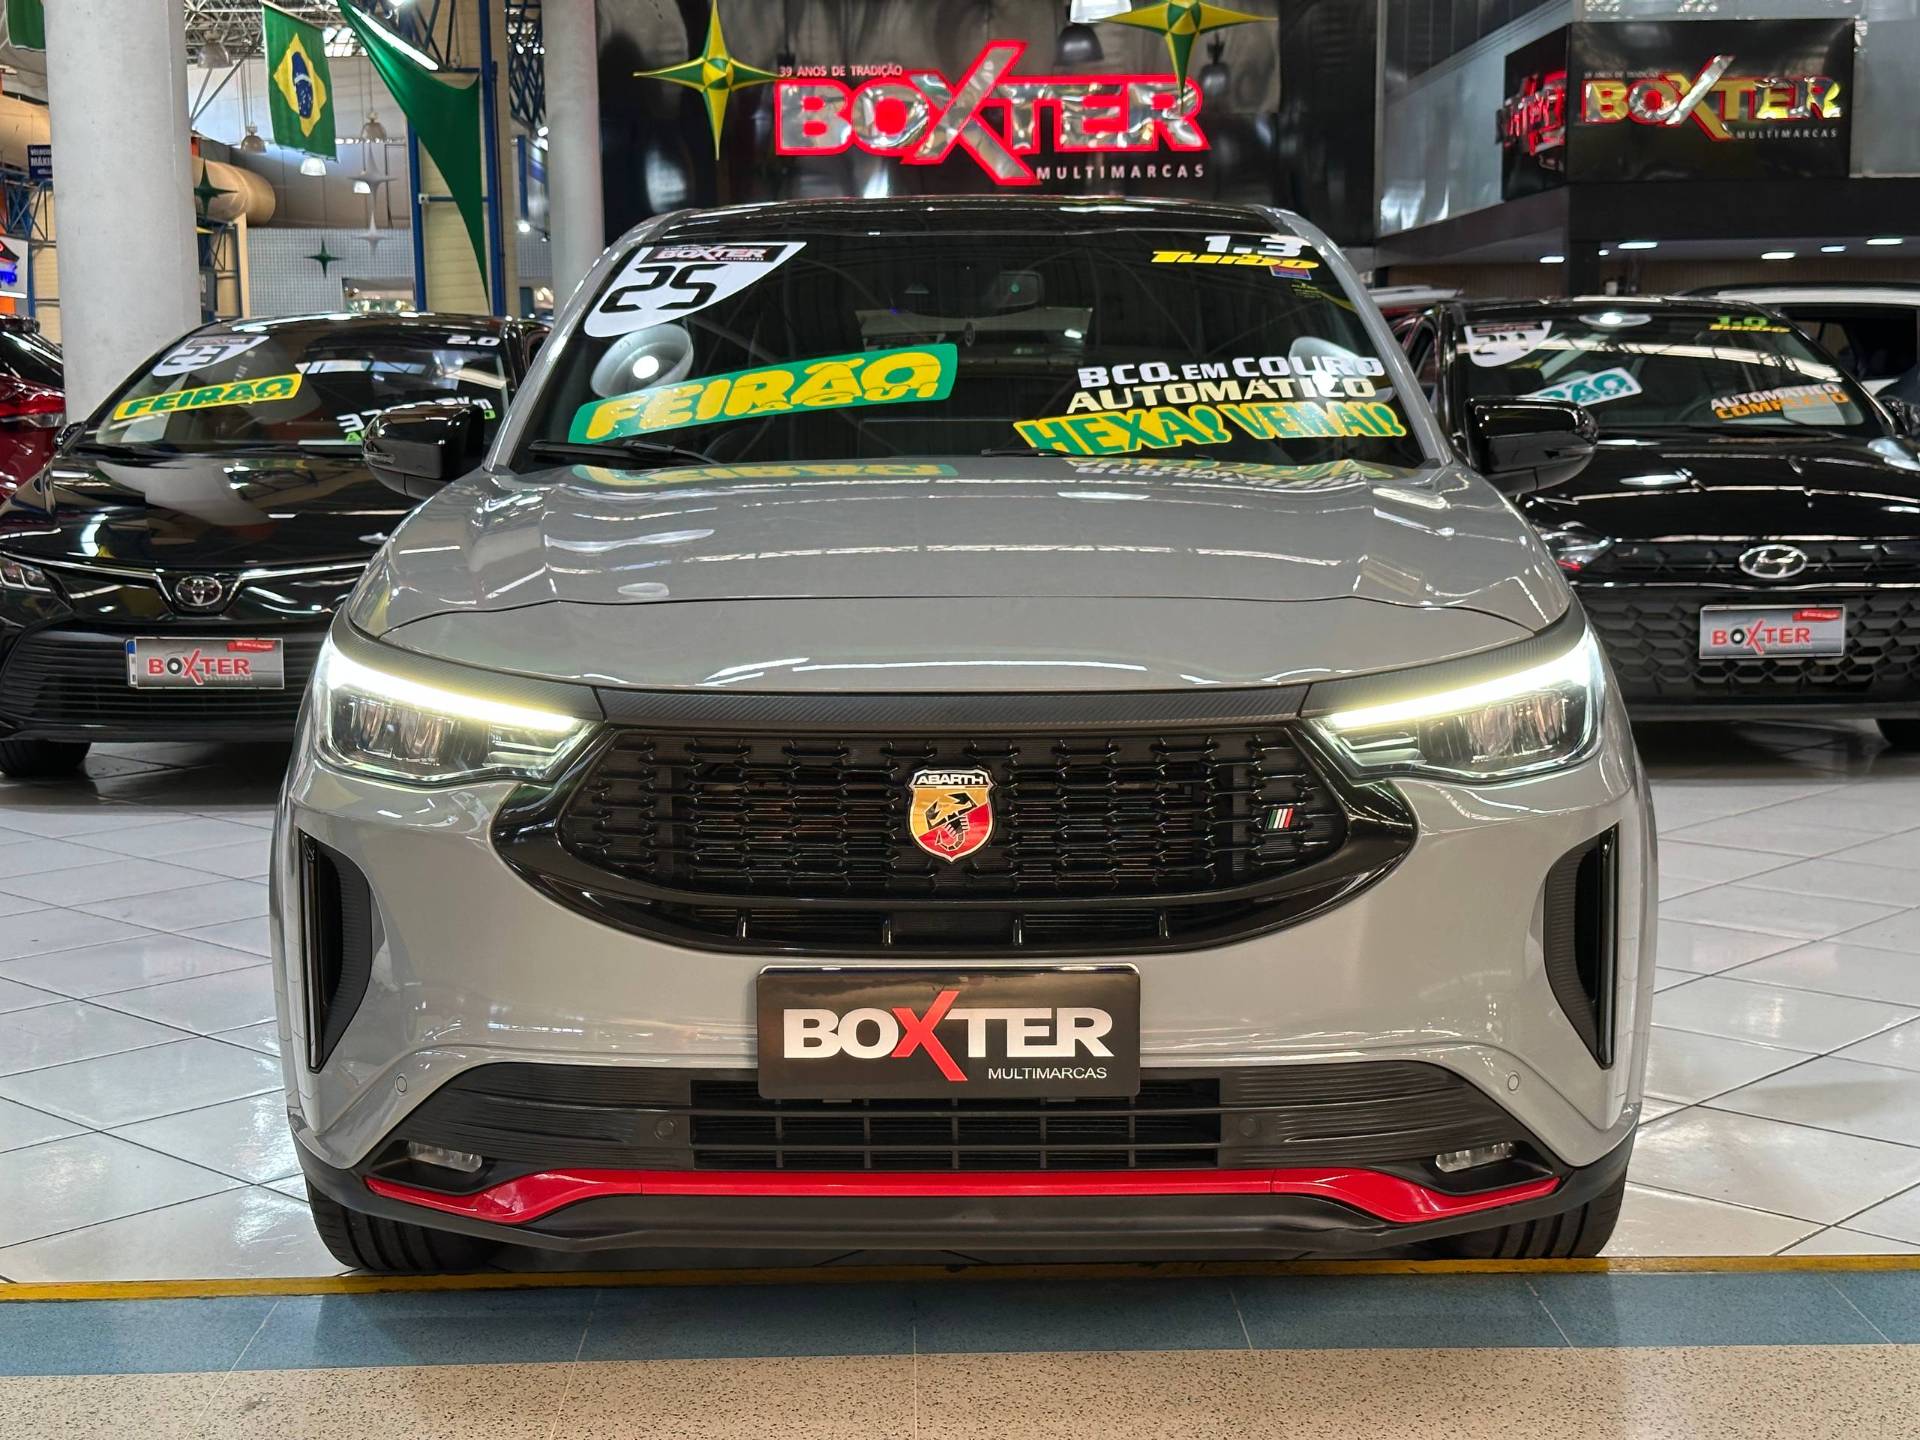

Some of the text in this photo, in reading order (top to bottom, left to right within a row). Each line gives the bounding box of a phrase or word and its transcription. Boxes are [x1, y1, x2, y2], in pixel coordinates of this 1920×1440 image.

[797, 65, 828, 77] ANOS
[831, 65, 847, 77] DE
[850, 62, 904, 79] TRADIÇÃO
[1582, 54, 1842, 141] BOXTER
[775, 40, 1212, 186] BOXTER
[1736, 127, 1838, 140] MULTIMARCAS
[1036, 163, 1205, 181] MULTIMARCAS
[654, 246, 768, 260] BOXTER
[1204, 235, 1309, 257] 1.3
[1151, 251, 1320, 269] Turbo
[599, 263, 728, 314] 25
[446, 334, 501, 347] 2.0
[1183, 364, 1229, 381] EM
[1233, 356, 1386, 379] COURO
[585, 351, 943, 440] FEIRÃO
[1065, 376, 1377, 415] AUTOMÁTICO
[1014, 405, 1231, 455] HEXA!
[1712, 619, 1812, 654] BOXTER
[148, 648, 252, 685] BOXTER
[916, 773, 984, 785] ABARTH
[783, 990, 1115, 1082] BOXTER
[987, 1066, 1108, 1081] MULTIMARCAS
